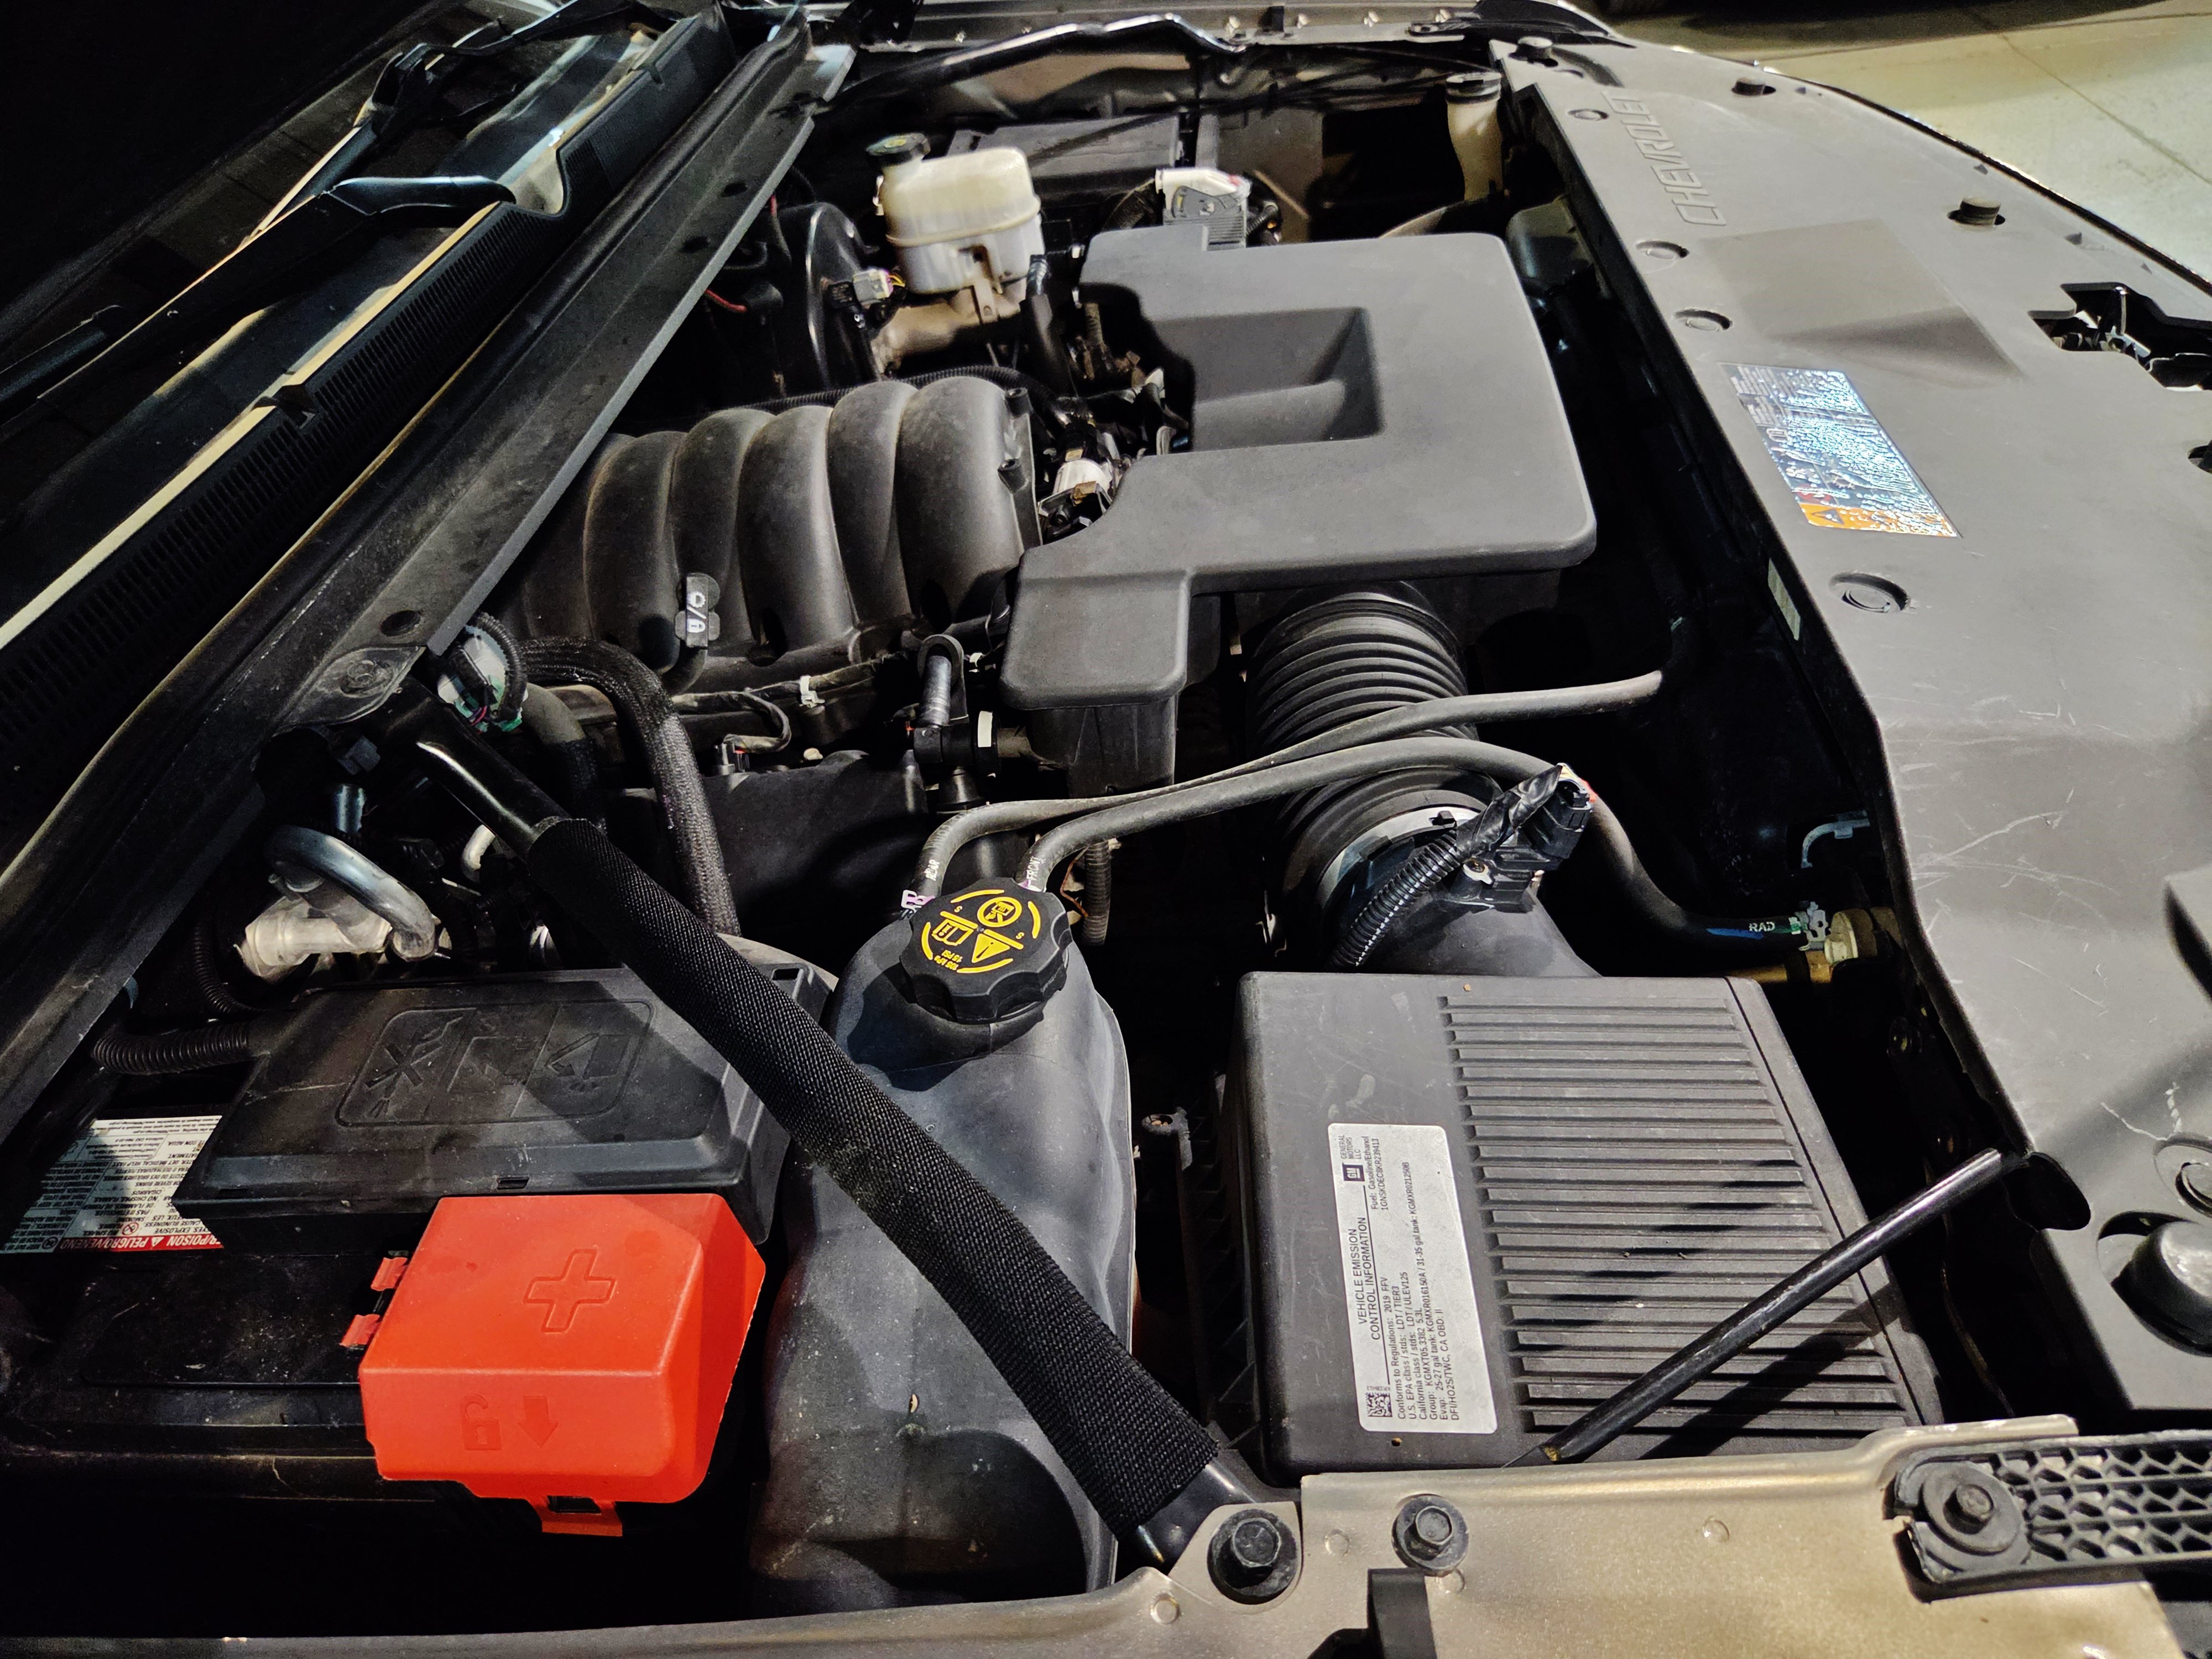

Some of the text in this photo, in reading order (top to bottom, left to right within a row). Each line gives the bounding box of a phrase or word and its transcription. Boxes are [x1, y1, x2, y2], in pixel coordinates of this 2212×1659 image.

[1601, 91, 1726, 227] CHEVROLET
[1026, 855, 1043, 881] FRONT
[1749, 921, 1776, 932] RAD
[941, 950, 956, 959] PSI
[1338, 1134, 1347, 1159] GENERAL
[1345, 1136, 1354, 1159] MOTORS
[1361, 1135, 1378, 1209] Fuel: Gasoline/Ethanol
[1410, 1215, 1420, 1233] tank:
[59, 1237, 150, 1249] PELIGRO/VENENO
[166, 1234, 221, 1246] R/POISON
[1412, 1234, 1423, 1245] gal
[1414, 1246, 1425, 1266] 31-35
[1348, 1229, 1368, 1324] VEHICLE EMISSION
[1357, 1217, 1380, 1339] CONTROL INFORMATION
[1380, 1276, 1389, 1291] FFV
[1391, 1285, 1402, 1307] TIER3
[1399, 1271, 1411, 1305] ULEV125
[1382, 1295, 1392, 1312] 2019
[1395, 1313, 1405, 1329] LDT
[1405, 1311, 1415, 1326] LDT
[1413, 1307, 1424, 1323] 5.3L
[1435, 1316, 1447, 1337] OBD:
[1385, 1317, 1401, 1366] Regulations:
[1397, 1334, 1408, 1353] stds:
[1407, 1331, 1418, 1350] stds:
[1427, 1334, 1438, 1353] tank:
[1439, 1339, 1449, 1351] CA
[1401, 1360, 1411, 1381] class
[1411, 1357, 1421, 1378] class
[1431, 1355, 1442, 1367] gal
[1433, 1369, 1444, 1390] 25-27
[1393, 1378, 1406, 1419] Conforms
[1404, 1384, 1414, 1400] EPA
[1414, 1380, 1427, 1419] California
[1407, 1402, 1417, 1419] U.S.
[1426, 1391, 1439, 1420] Group:
[1437, 1397, 1450, 1420] Evap:
